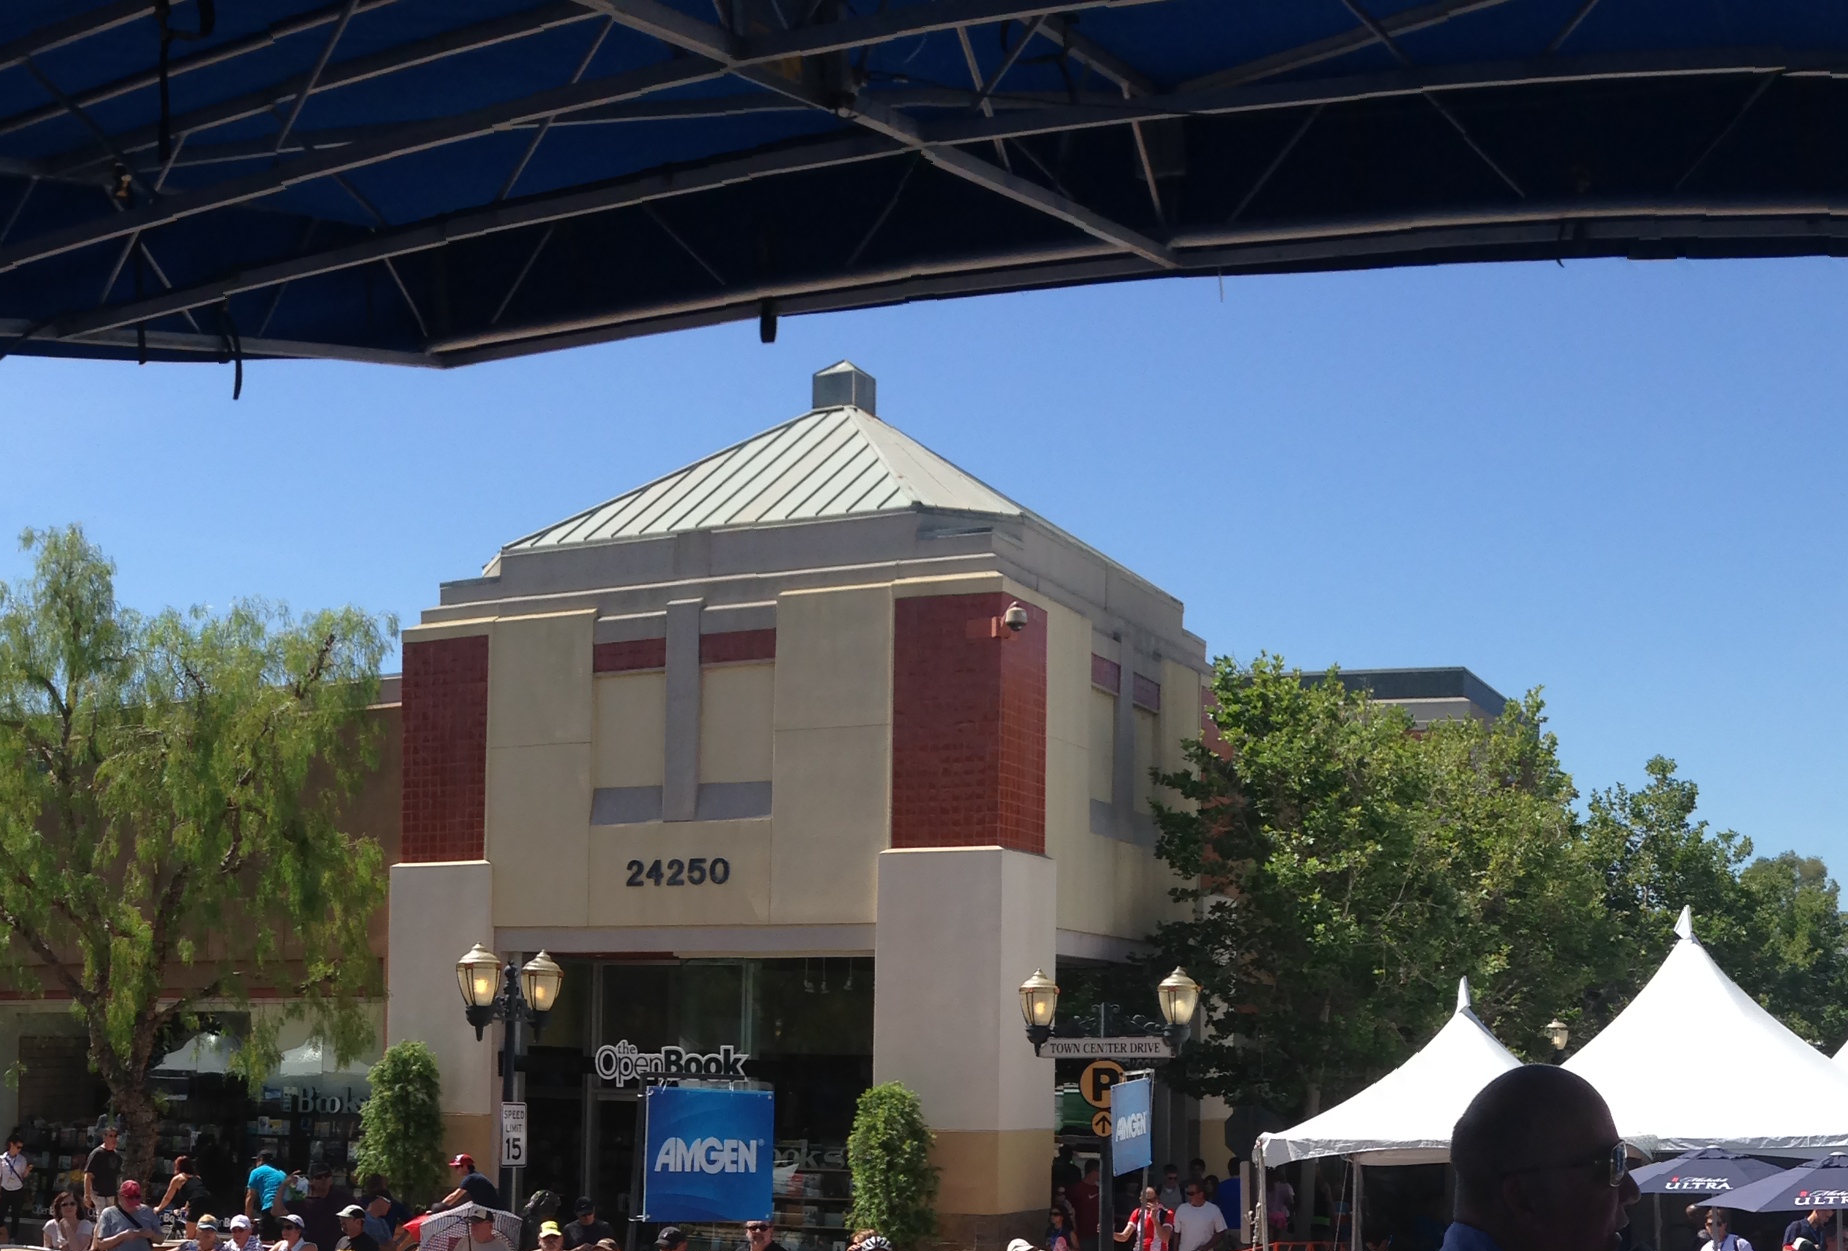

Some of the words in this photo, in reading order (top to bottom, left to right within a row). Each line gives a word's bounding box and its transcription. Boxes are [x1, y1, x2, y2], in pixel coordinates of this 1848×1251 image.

[626, 857, 730, 887] 24250
[617, 1042, 637, 1055] the
[1051, 1043, 1081, 1053] TOWN
[1083, 1043, 1128, 1054] CENTER
[1130, 1042, 1160, 1054] DRIVE
[1093, 1068, 1121, 1101] P
[503, 1110, 525, 1119] SPEED
[505, 1124, 522, 1133] LIMIT
[1116, 1112, 1146, 1142] AMGEN
[506, 1137, 522, 1160] 15
[654, 1137, 756, 1174] AMGEN
